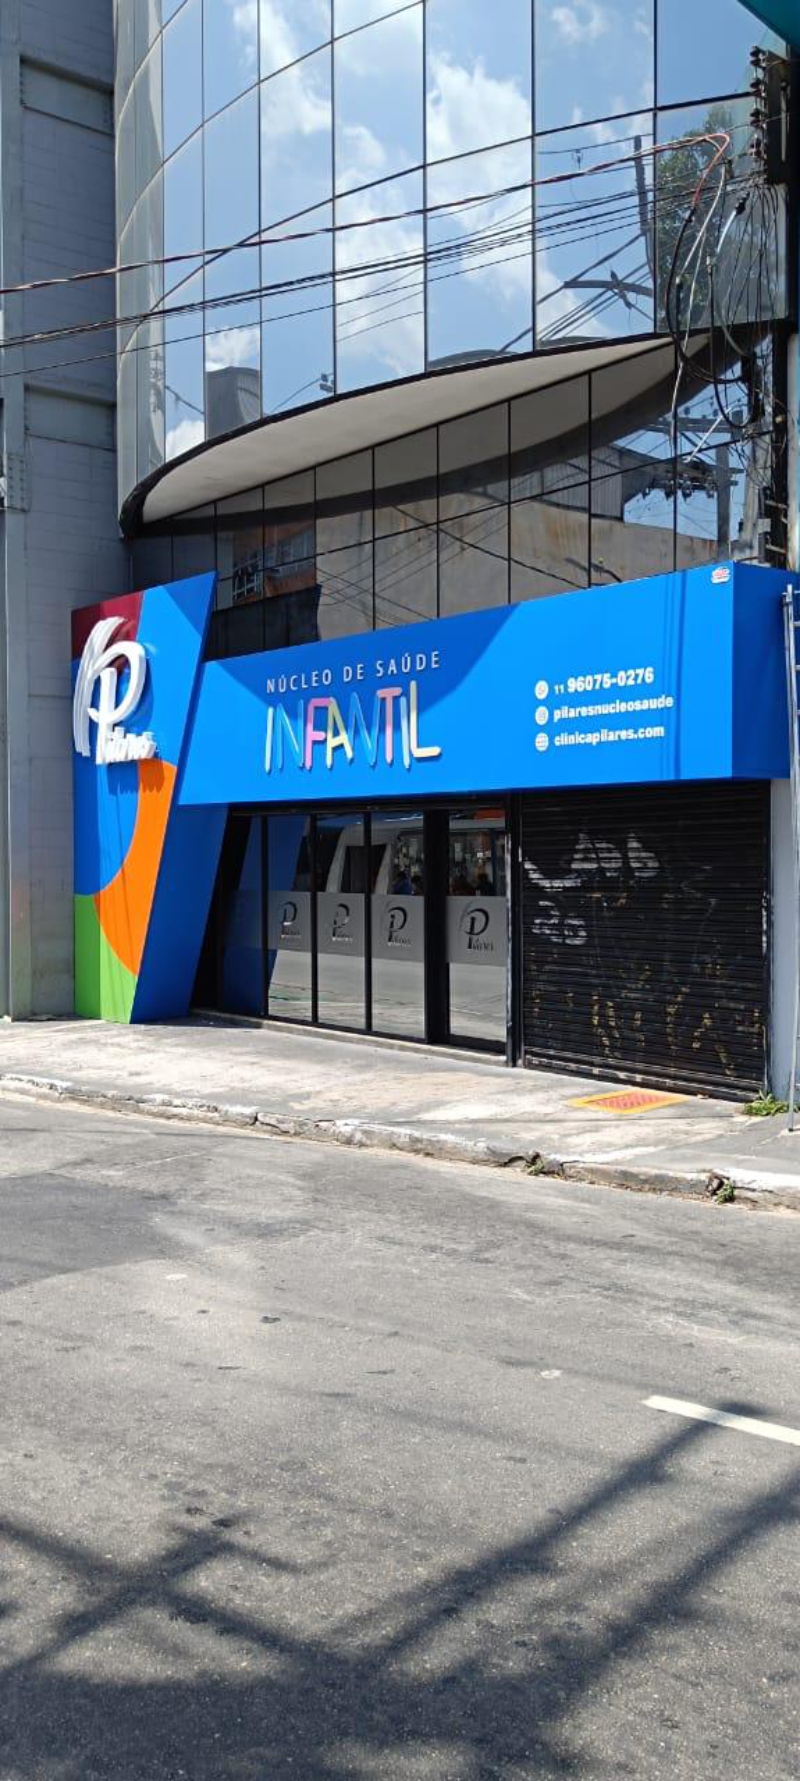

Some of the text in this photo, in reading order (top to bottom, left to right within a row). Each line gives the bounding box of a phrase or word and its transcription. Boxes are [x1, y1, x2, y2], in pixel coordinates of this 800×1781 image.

[266, 651, 441, 694] NÚCLEO DE SAÚDE
[553, 667, 655, 695] 11 96075-0276
[553, 694, 675, 723] pilaresnucleosaude
[264, 680, 442, 774] INFANTIL
[554, 726, 665, 747] clinicapilares.com
